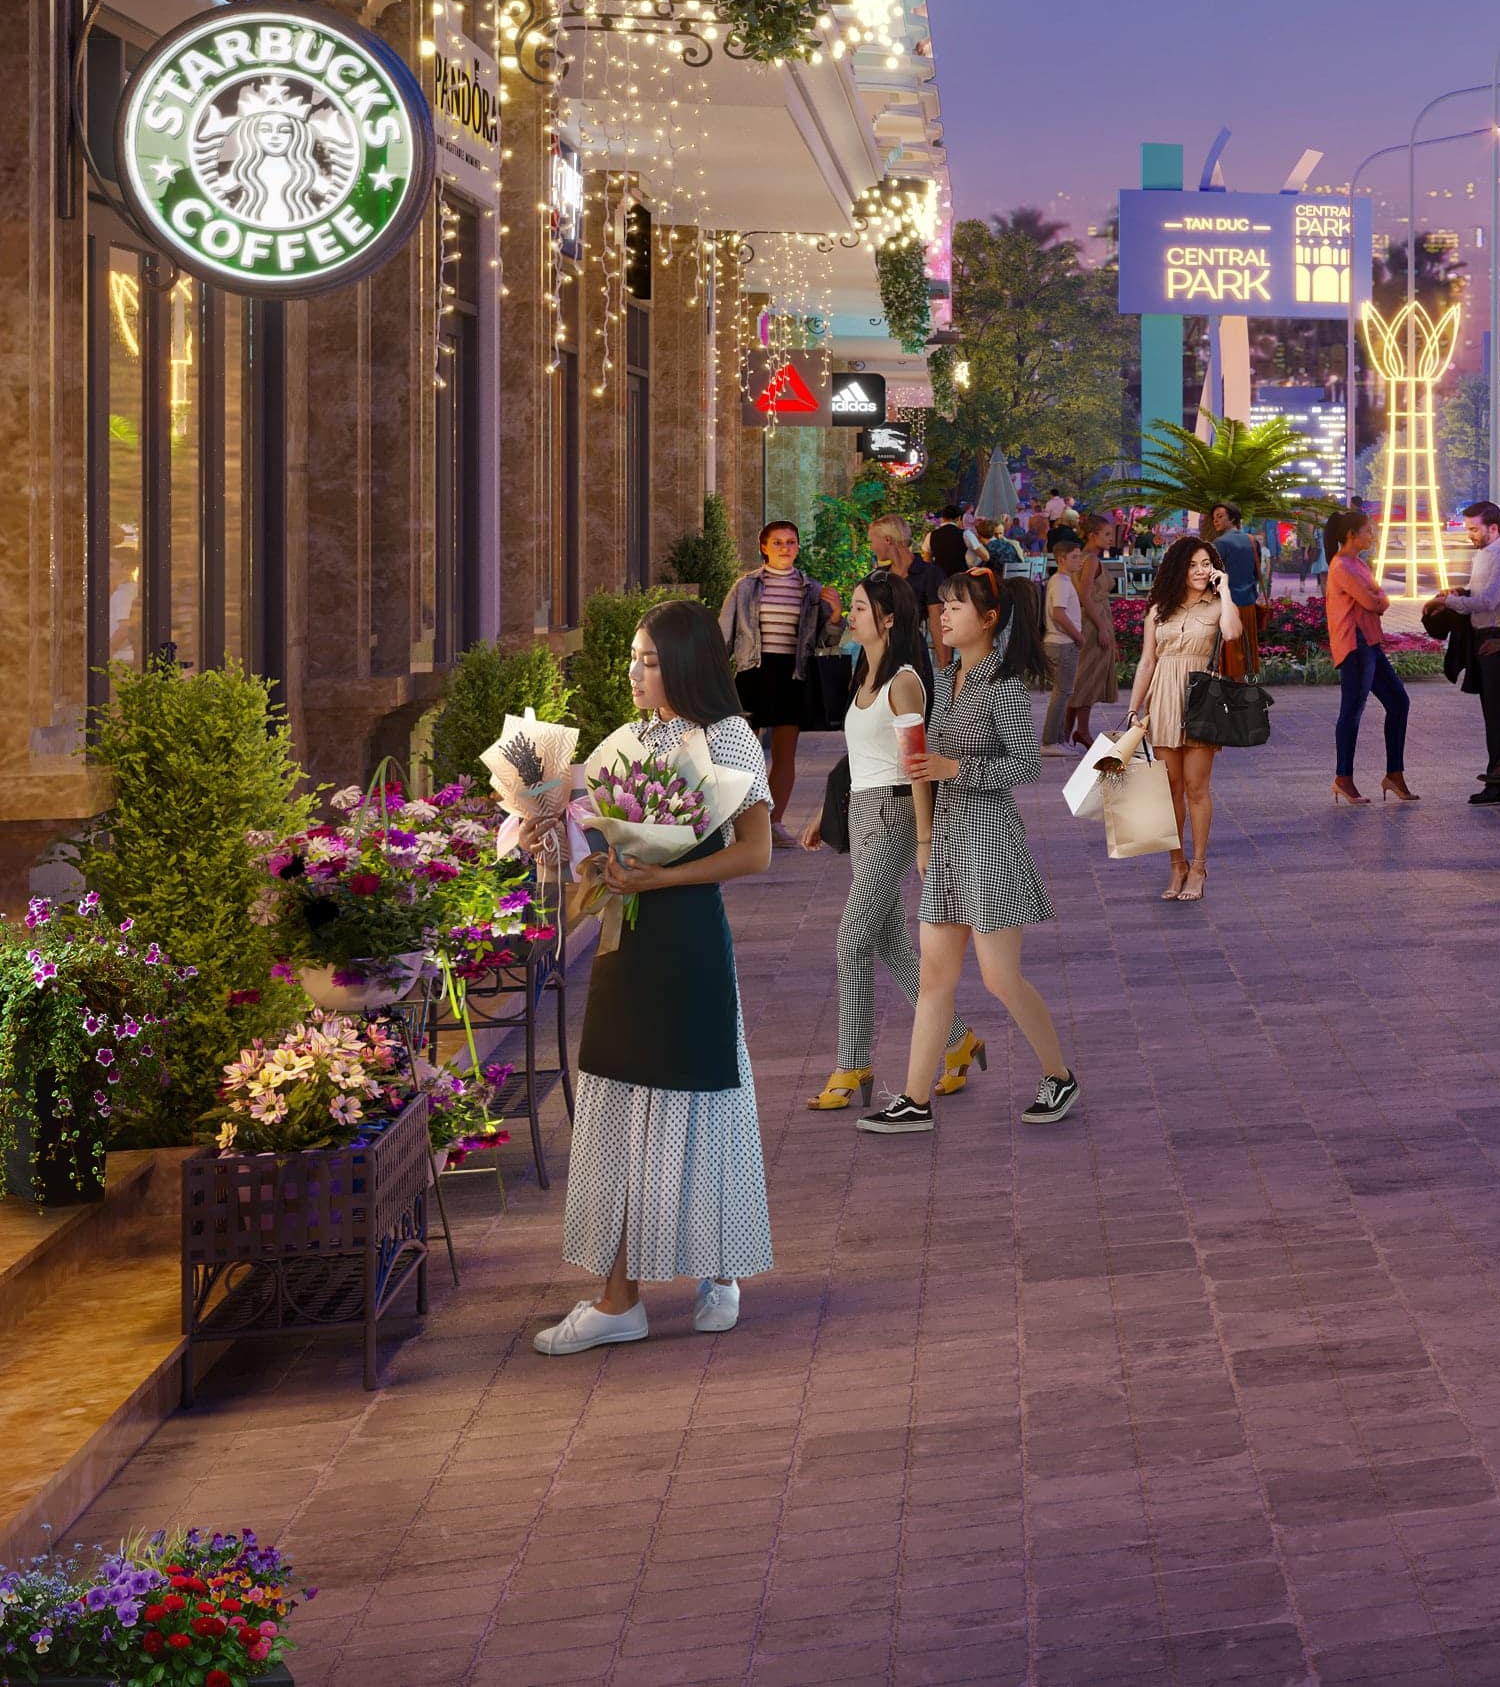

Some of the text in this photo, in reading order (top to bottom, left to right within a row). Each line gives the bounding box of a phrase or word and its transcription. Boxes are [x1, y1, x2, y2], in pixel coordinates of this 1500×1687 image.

[145, 26, 404, 149] STARBUCKS
[434, 51, 499, 144] PANDORA
[1184, 217, 1250, 232] TAN DUC
[1295, 204, 1351, 218] CENTRA
[171, 198, 374, 272] COFFEE
[1295, 217, 1351, 238] PARK
[1166, 247, 1271, 267] CENTRAL
[1167, 268, 1271, 301] PARK
